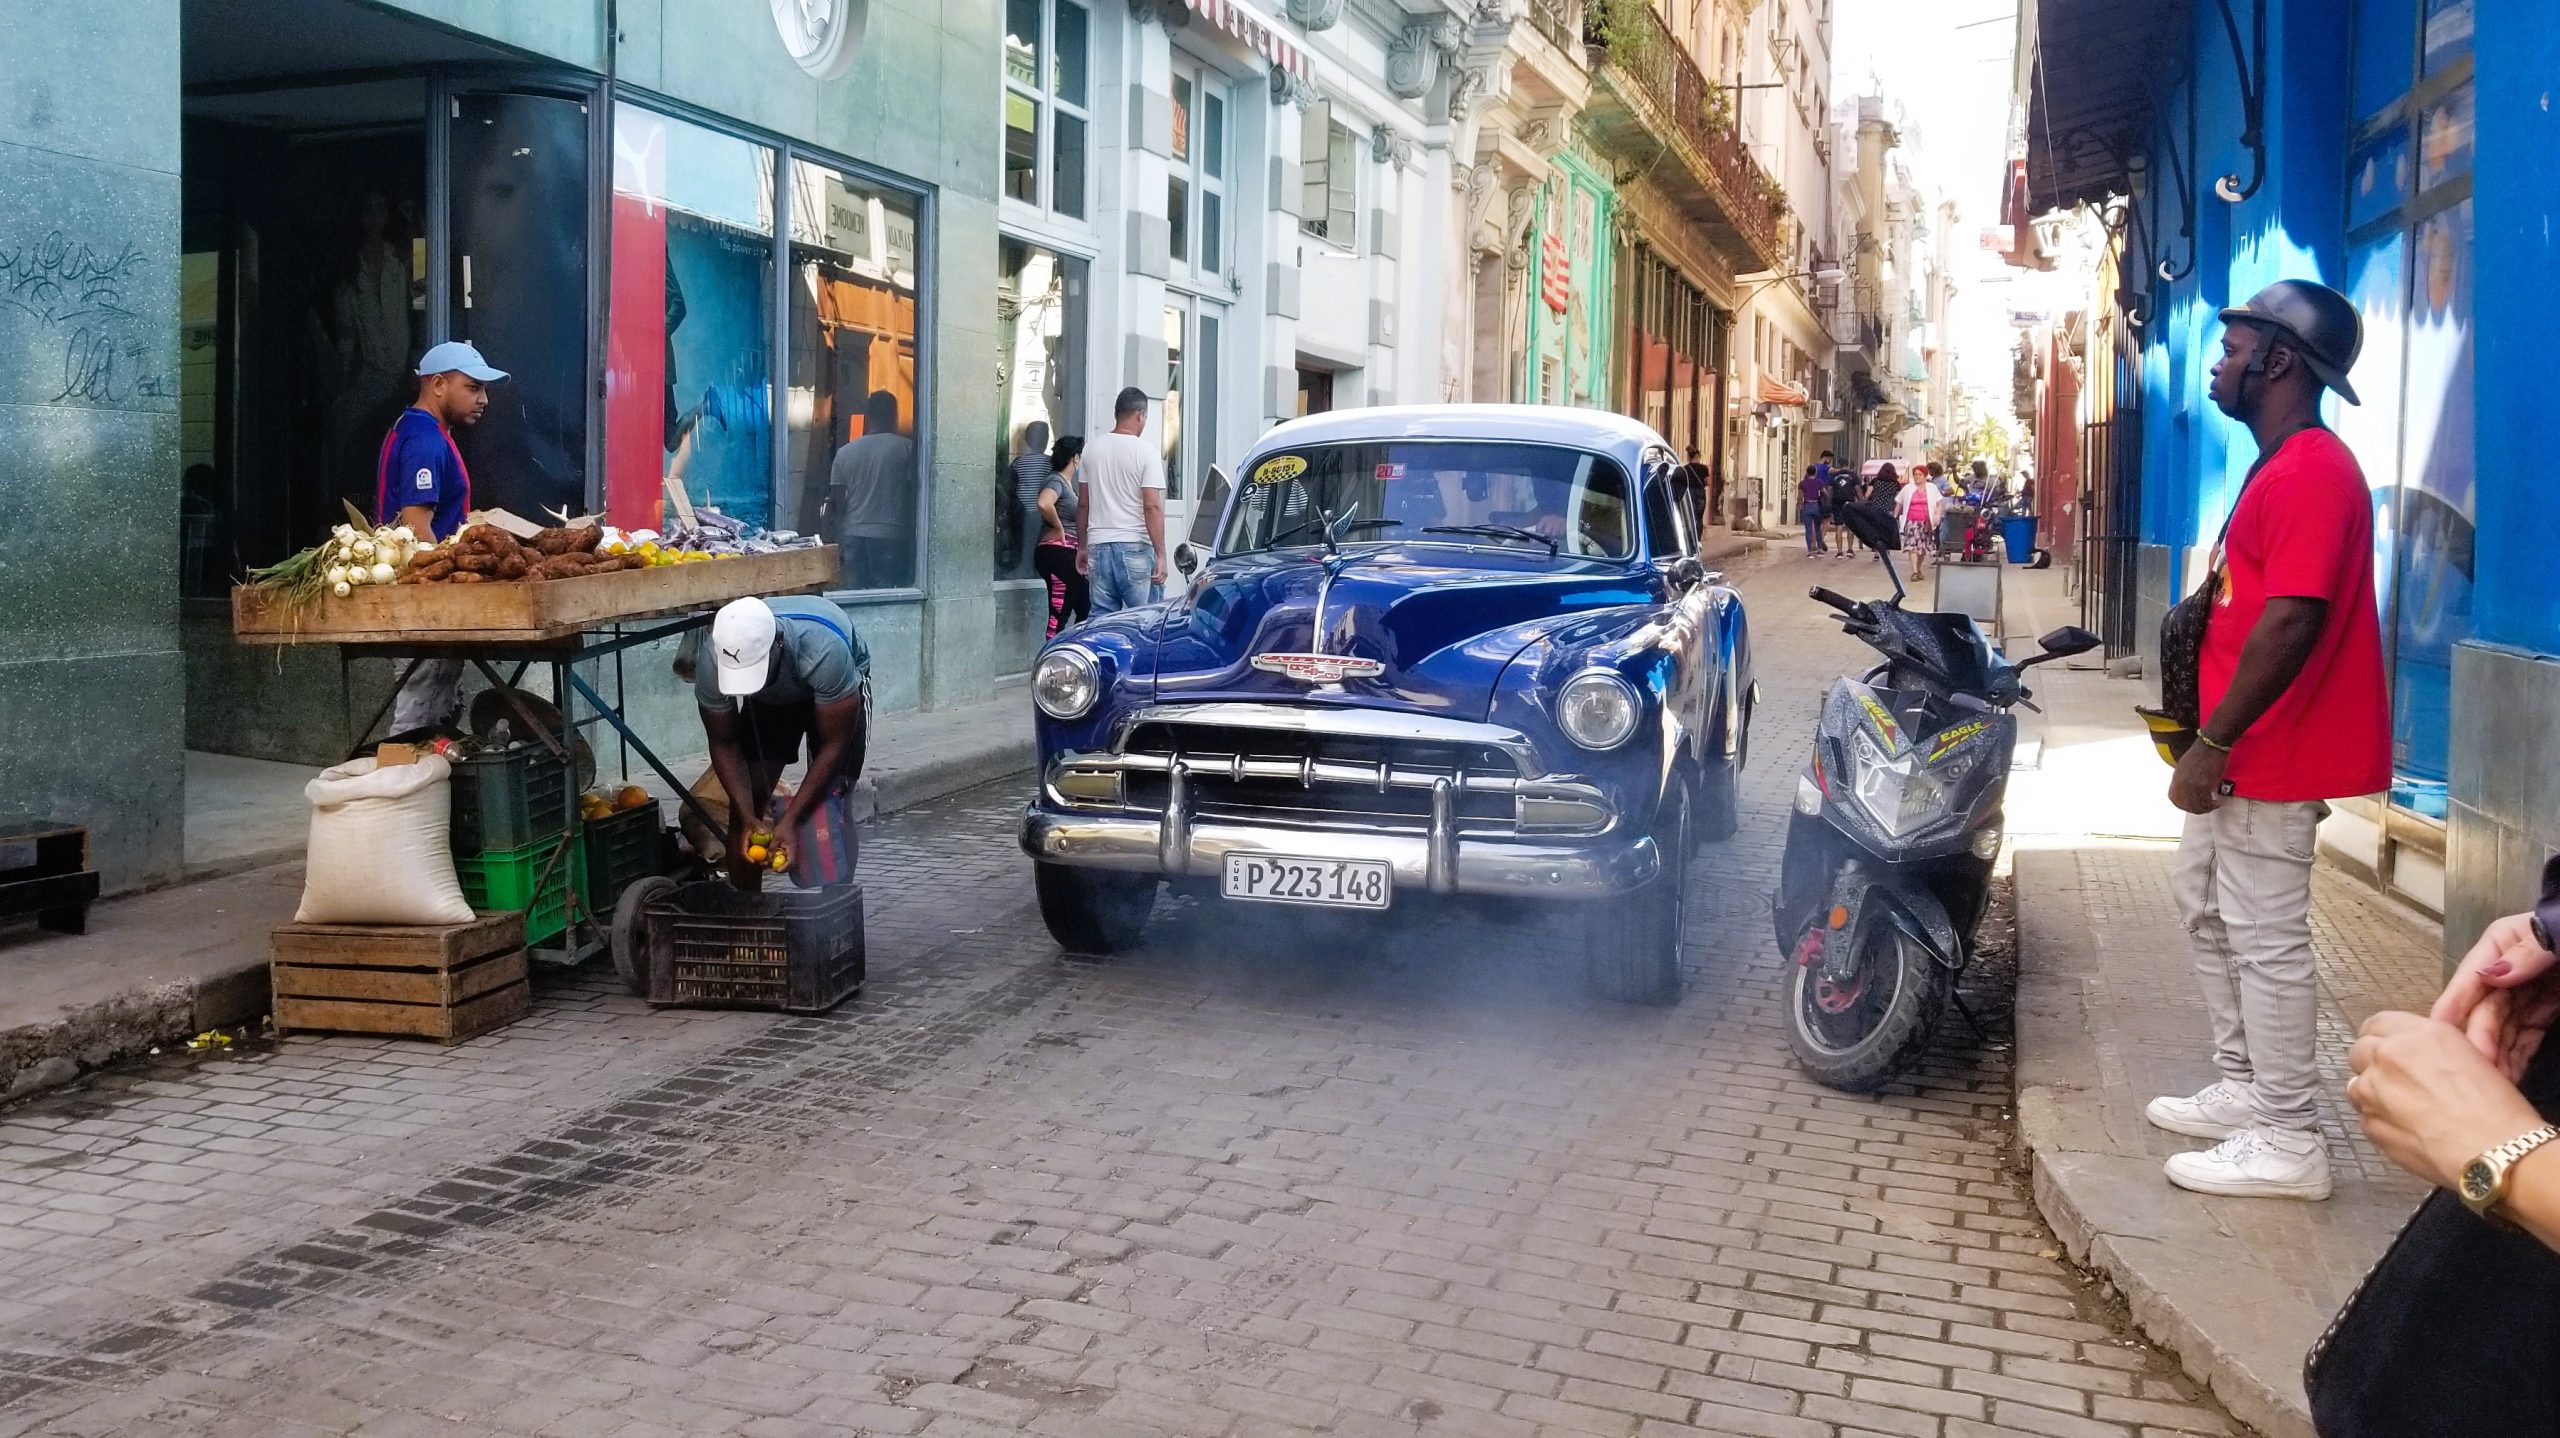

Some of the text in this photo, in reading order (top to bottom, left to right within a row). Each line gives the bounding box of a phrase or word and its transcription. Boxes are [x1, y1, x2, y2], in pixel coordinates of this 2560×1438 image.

[719, 237, 731, 251] The
[732, 243, 751, 254] power
[1940, 721, 1985, 742] EAGLE
